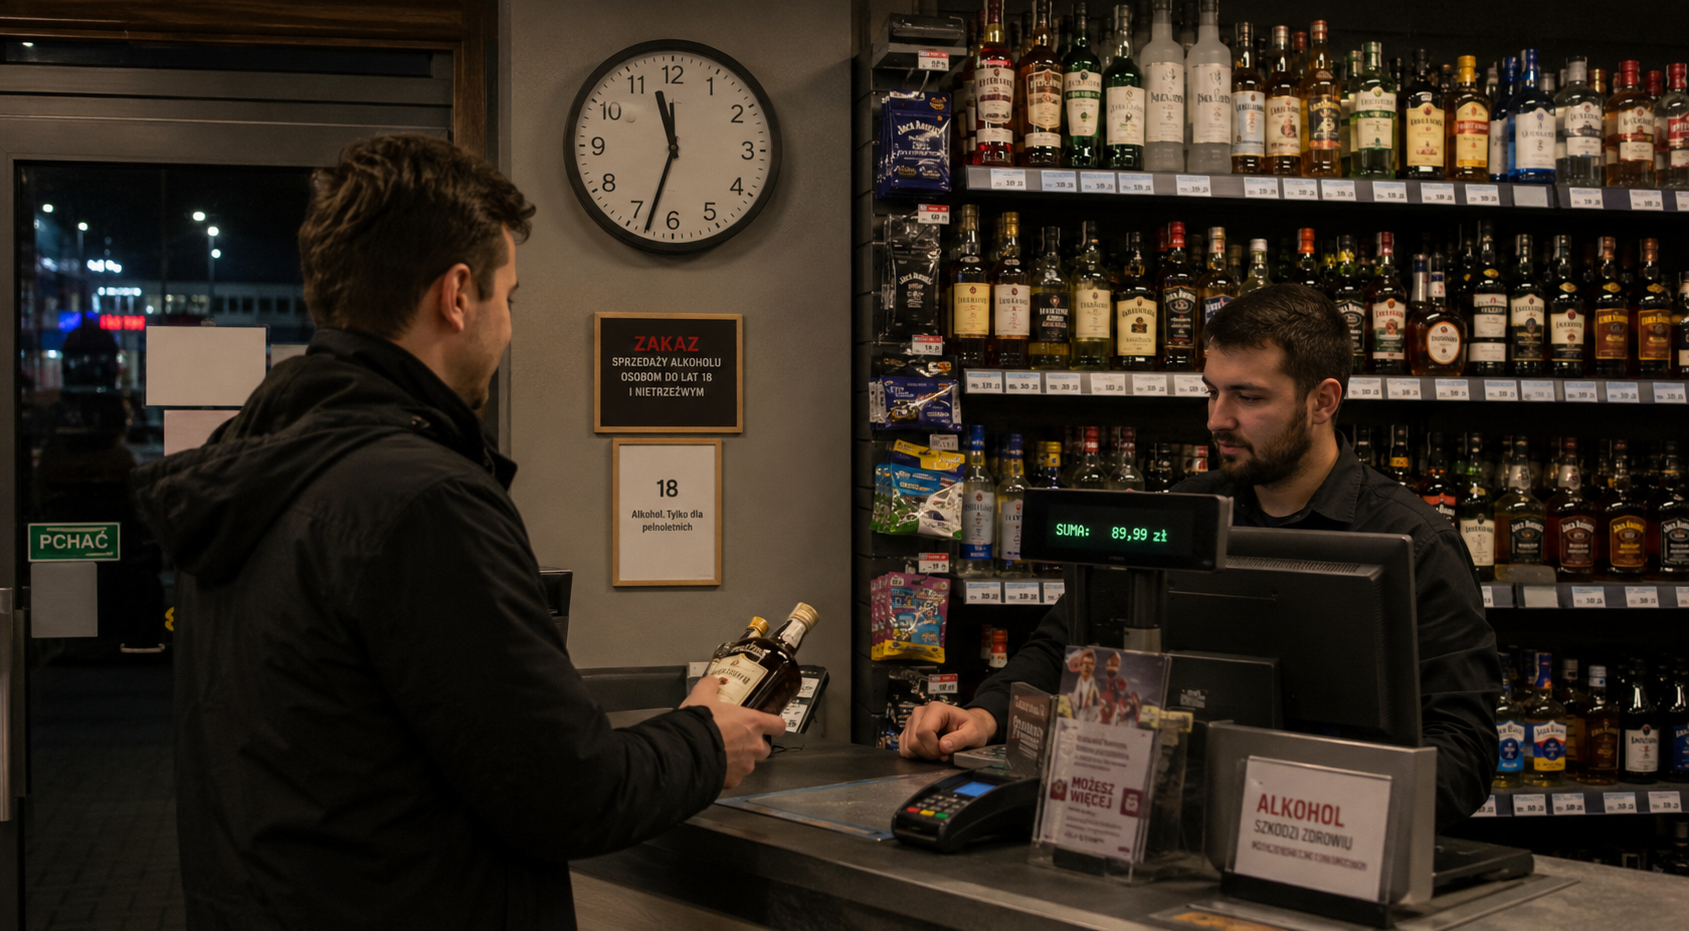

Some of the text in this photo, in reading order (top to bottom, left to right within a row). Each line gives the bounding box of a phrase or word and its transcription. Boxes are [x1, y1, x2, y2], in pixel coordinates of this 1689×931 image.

[627, 75, 645, 94] 11
[661, 64, 684, 85] 12
[706, 77, 714, 96] 1
[599, 101, 622, 121] 10
[730, 104, 744, 124] 2
[591, 136, 606, 156] 9
[741, 141, 755, 161] 3
[601, 173, 617, 193] 8
[730, 177, 744, 197] 4
[630, 200, 644, 219] 7
[703, 202, 717, 221] 5
[666, 210, 680, 230] 6
[634, 335, 700, 352] ZAKAZ
[612, 355, 722, 367] SPRZEDAŻY ALKOHOLU
[621, 371, 713, 382] OSOBOM DO LAT 18
[655, 479, 679, 498] 18
[631, 509, 704, 521] Alkohol. Tylko dla
[40, 530, 108, 549] PCHAĆ
[1055, 523, 1168, 543] SUMA: 89,99 zł
[1071, 776, 1115, 796] MOŻESZ
[1070, 790, 1113, 809] WIĘCEJ
[1257, 793, 1345, 828] ALKOHOL
[1254, 819, 1354, 851] SZKODZI ZDROWIU
